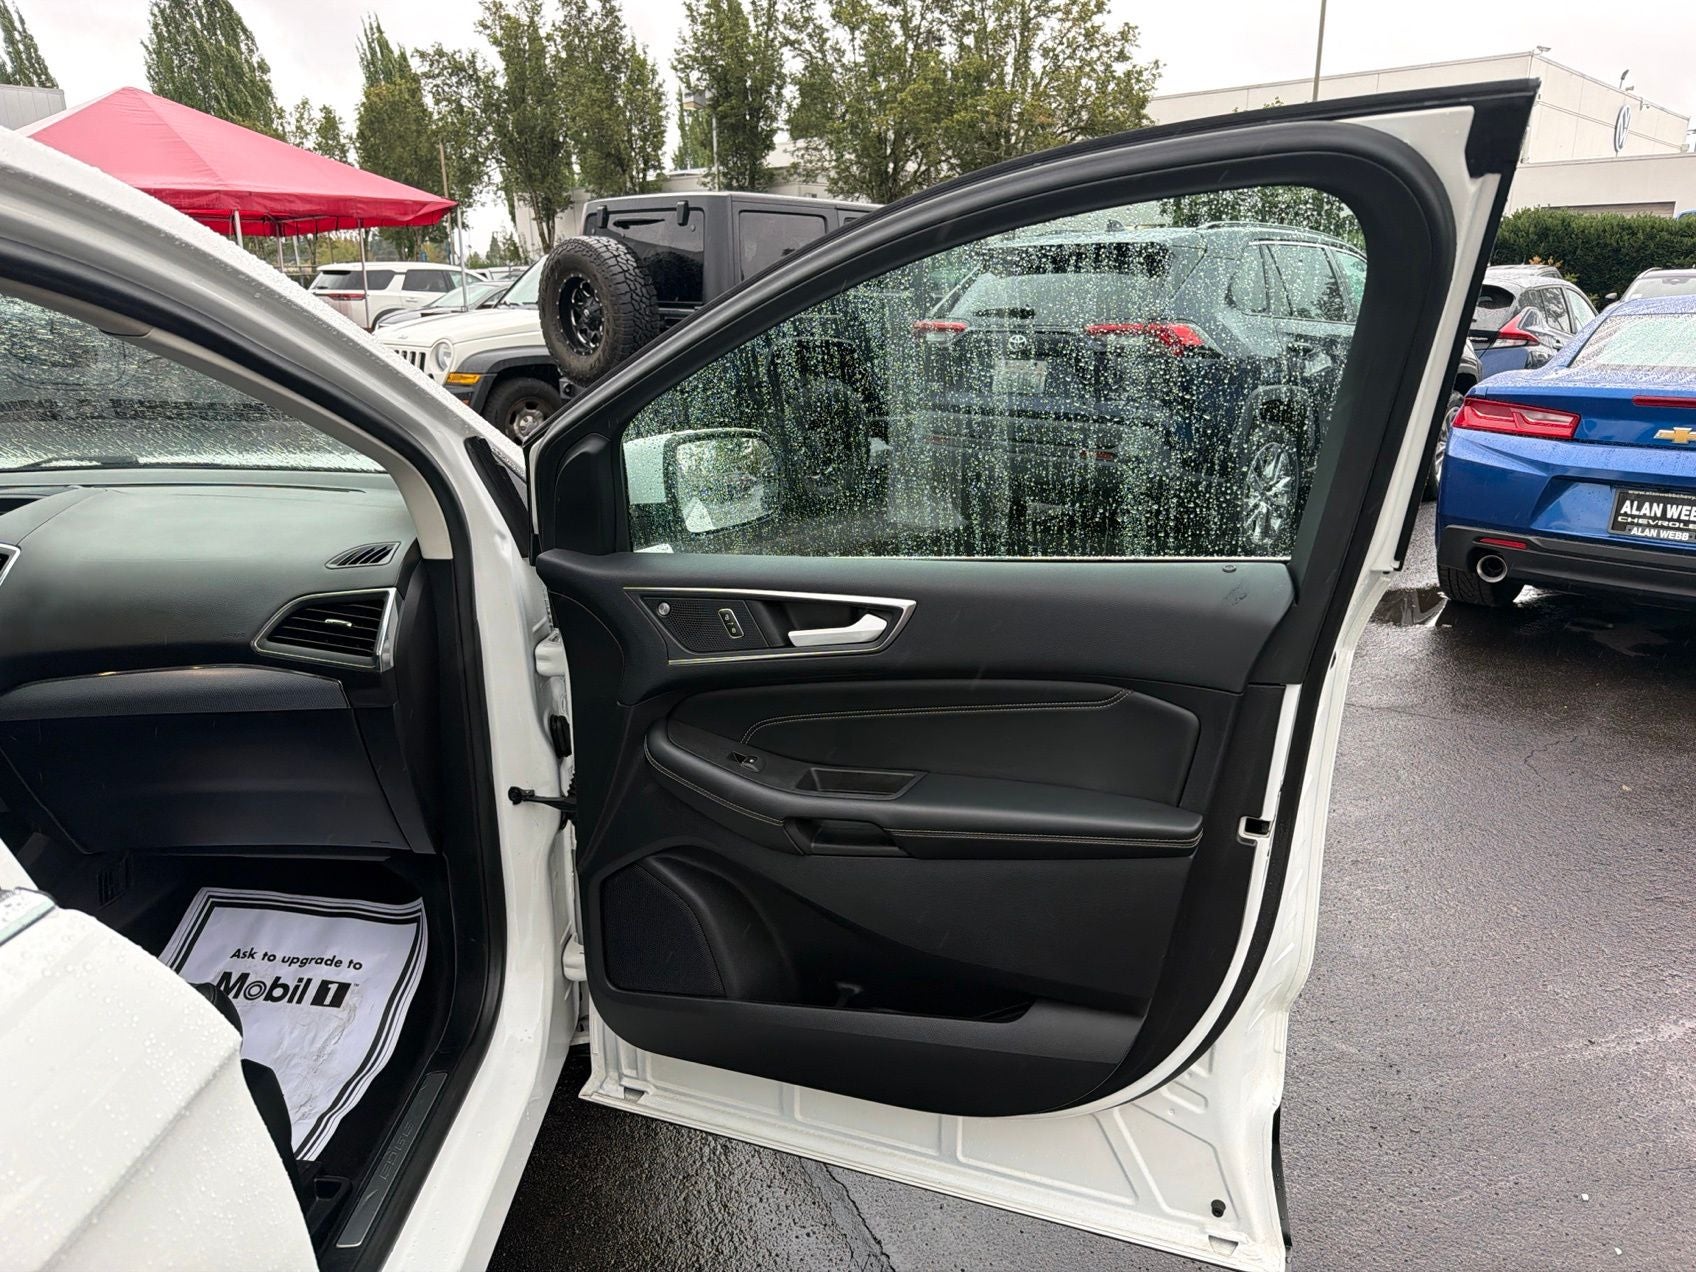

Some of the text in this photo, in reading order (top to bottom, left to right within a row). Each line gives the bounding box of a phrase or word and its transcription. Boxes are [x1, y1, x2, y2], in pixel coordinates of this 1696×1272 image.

[1619, 499, 1664, 518] ALAN
[1630, 526, 1690, 541] ALAN WEBB
[230, 947, 363, 971] Ask to upgrade to
[215, 971, 313, 1005] Mobil
